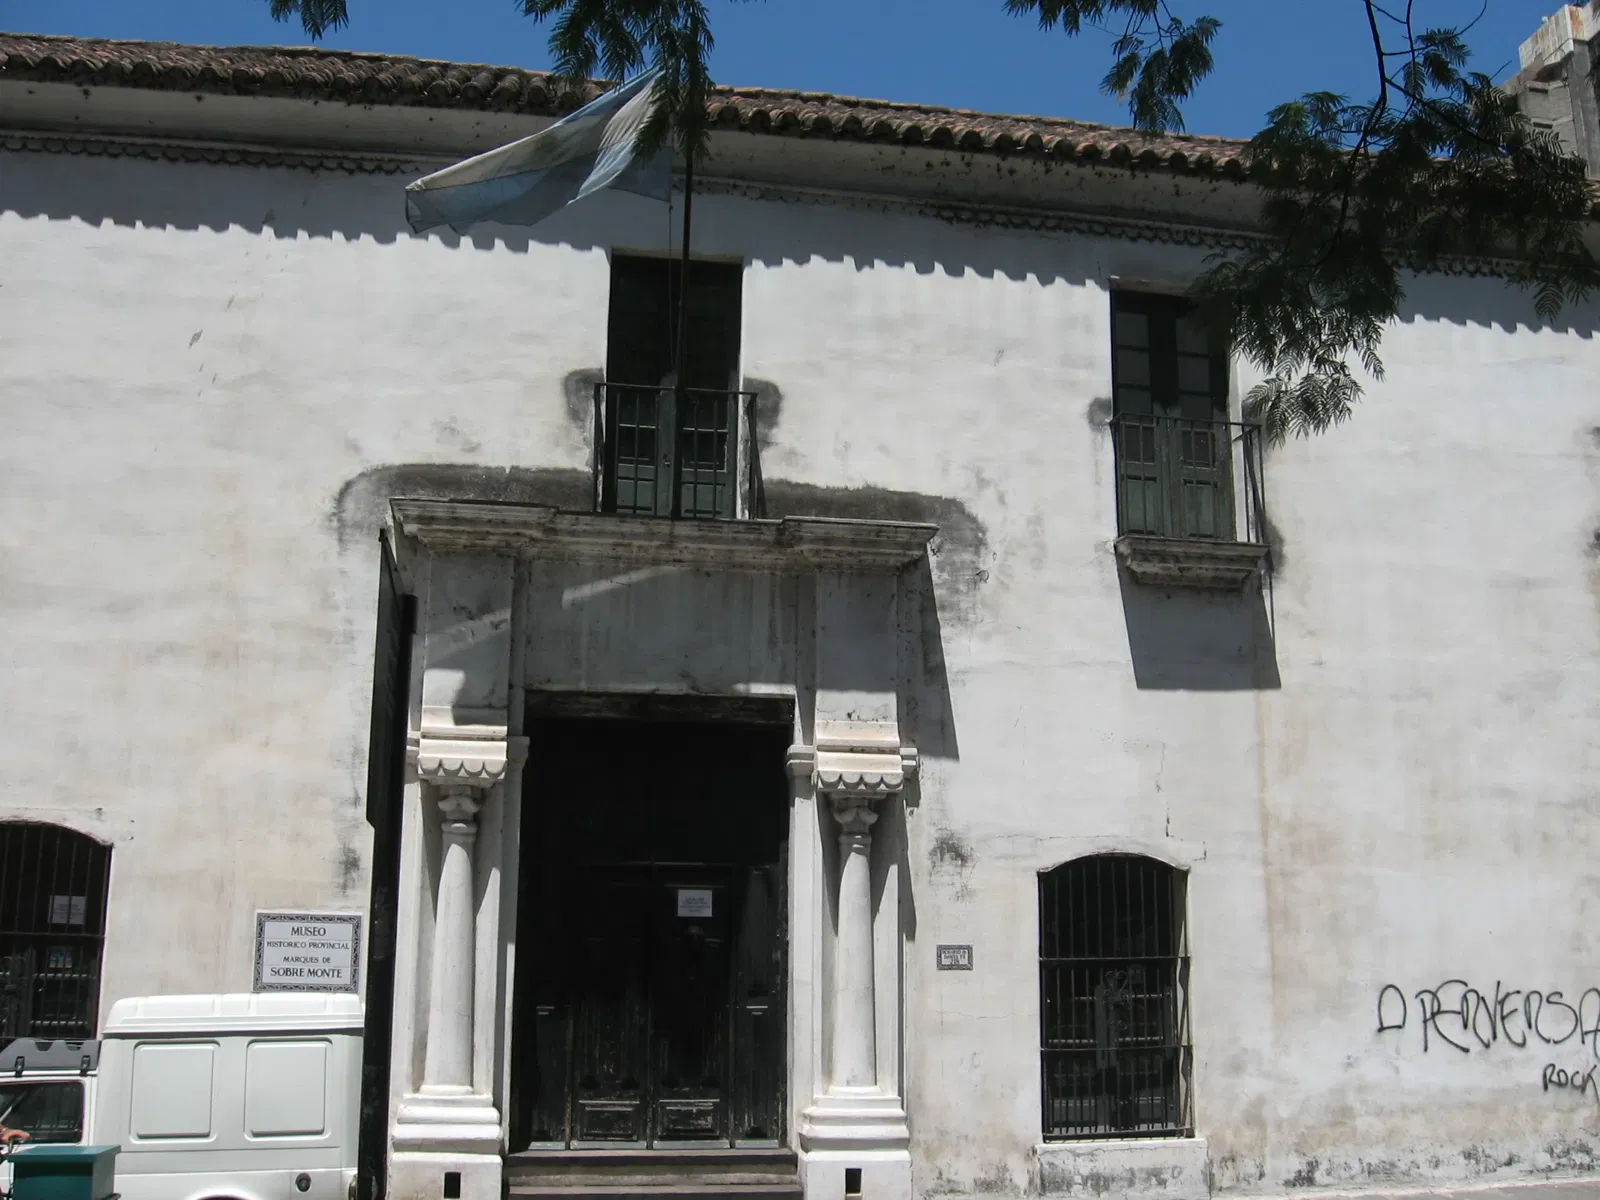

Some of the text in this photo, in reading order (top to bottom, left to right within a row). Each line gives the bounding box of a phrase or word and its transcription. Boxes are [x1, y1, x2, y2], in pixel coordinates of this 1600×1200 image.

[290, 926, 327, 937] MUSEO
[266, 940, 350, 950] HISTORICO PROVINCIAL
[282, 955, 332, 964] MARQUES DE
[270, 966, 343, 978] SOBRE MONTE
